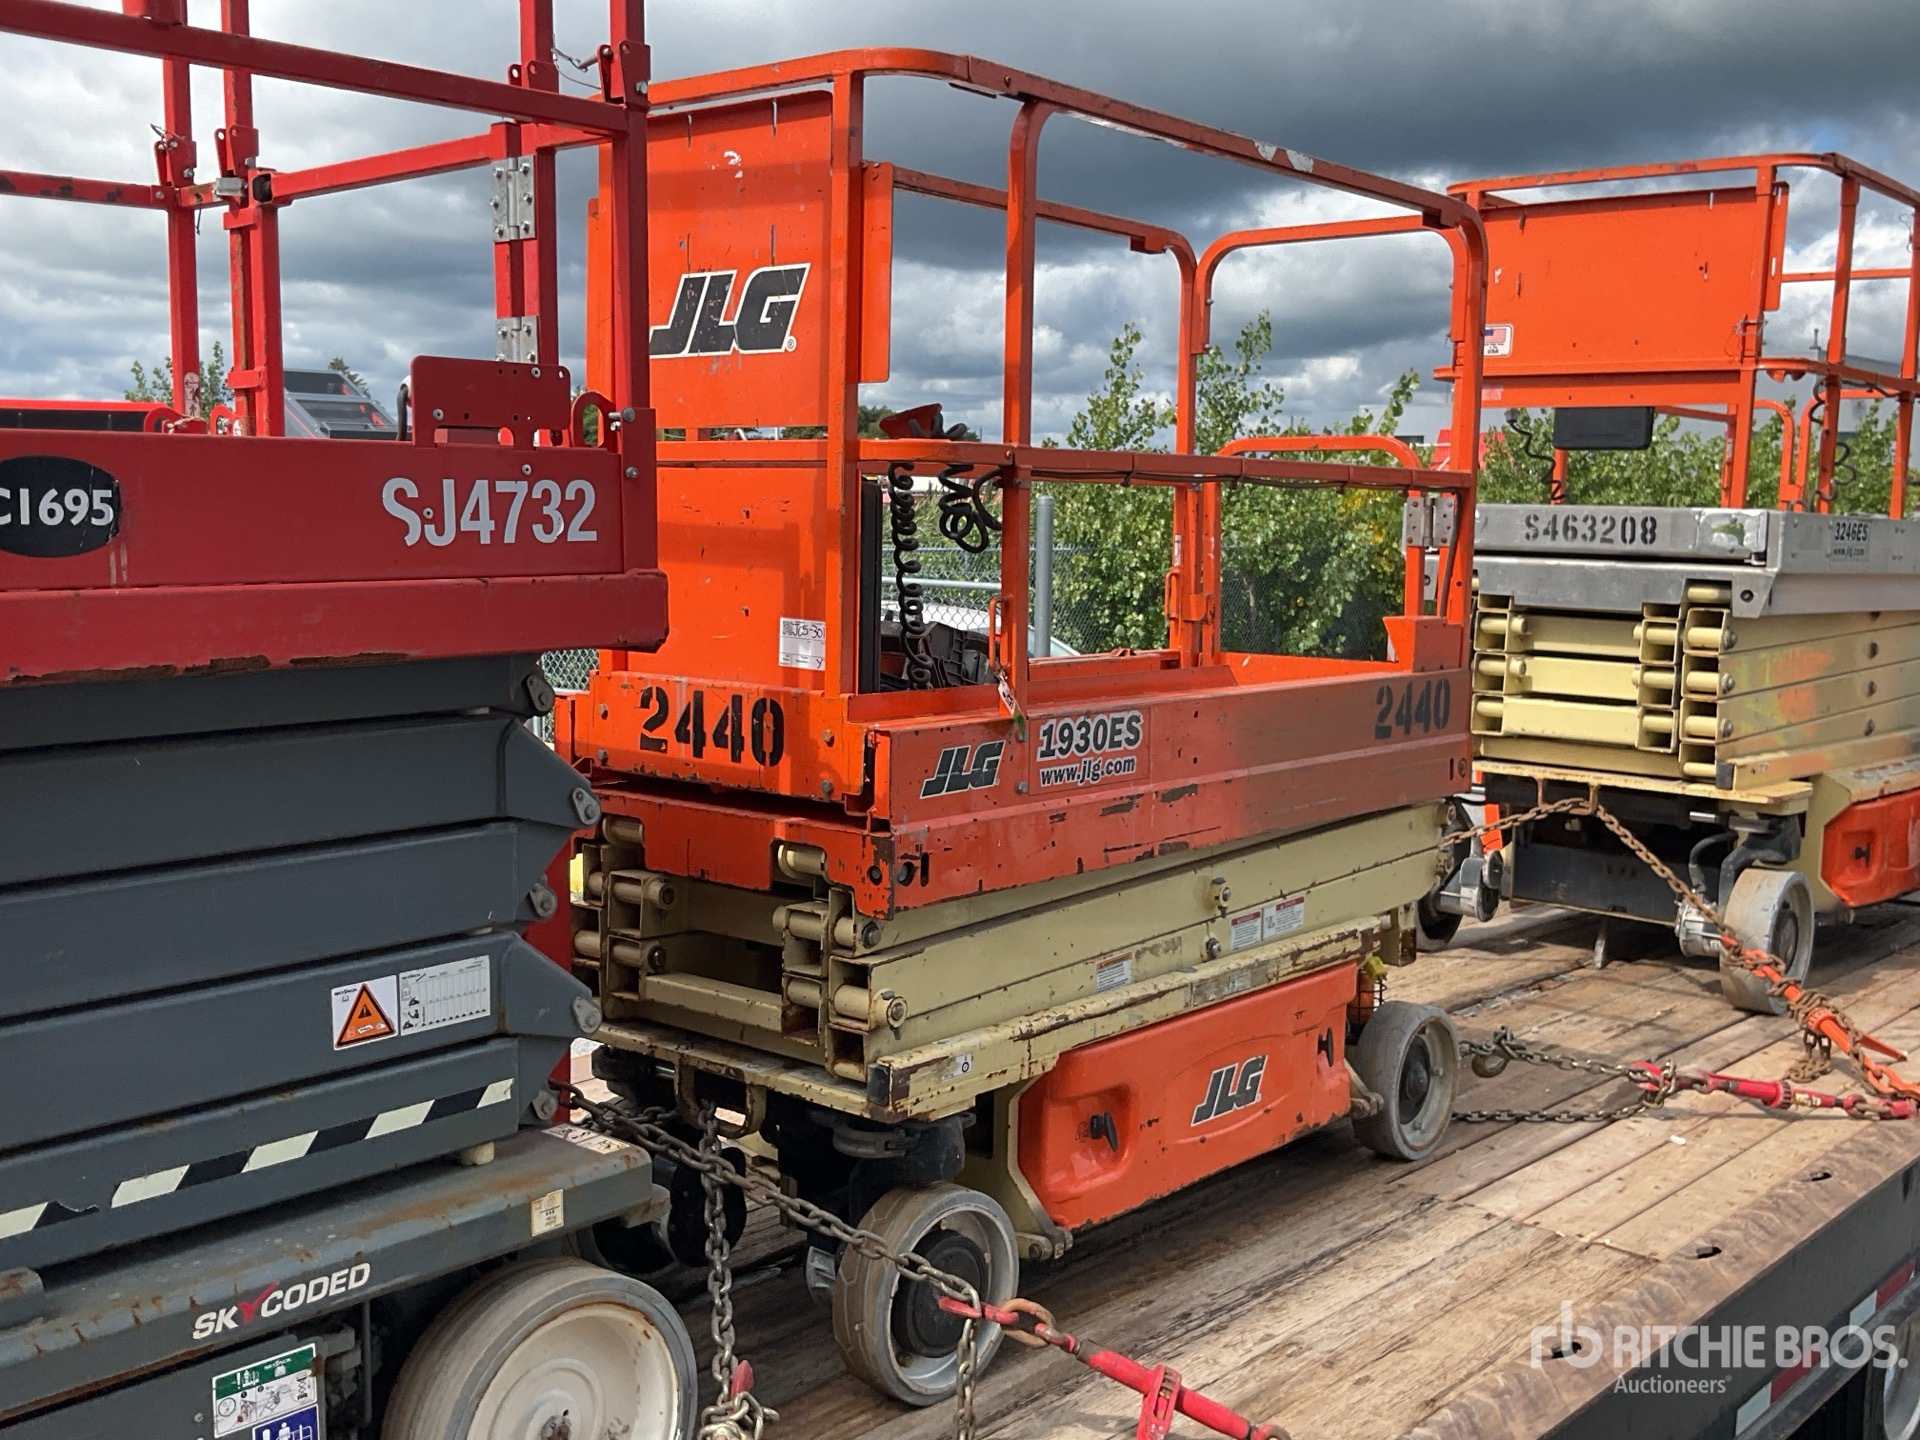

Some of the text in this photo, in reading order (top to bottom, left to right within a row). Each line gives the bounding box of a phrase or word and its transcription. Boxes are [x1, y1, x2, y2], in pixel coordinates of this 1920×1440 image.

[382, 477, 598, 547] SJ4732
[1524, 514, 1657, 545] S463208
[1834, 521, 1869, 541] 3246ES
[639, 686, 785, 767] 2440
[1038, 711, 1143, 760] 1930ES
[1375, 678, 1451, 739] 2440
[1040, 757, 1136, 786] www.jlg.com
[192, 1262, 371, 1340] SKYCODED
